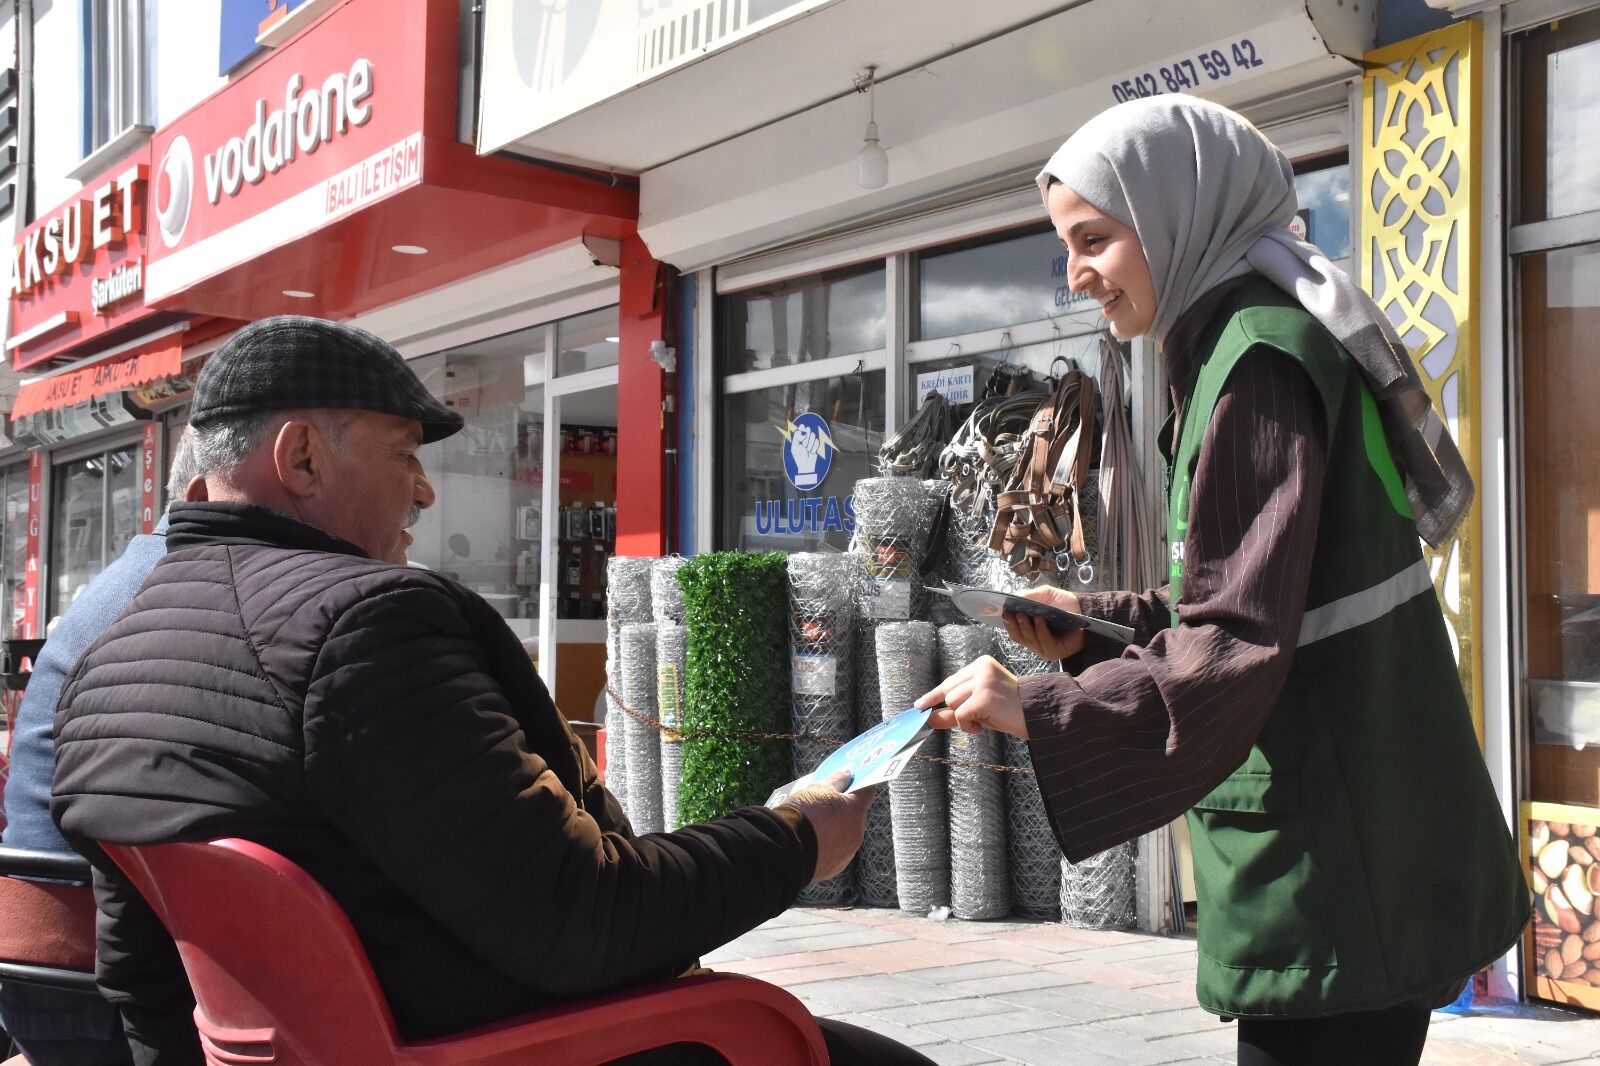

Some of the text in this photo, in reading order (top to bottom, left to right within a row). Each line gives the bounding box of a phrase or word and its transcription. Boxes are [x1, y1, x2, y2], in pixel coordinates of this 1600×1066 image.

[1111, 39, 1263, 104] 0542 847 59 42
[204, 58, 373, 205] vodafone
[360, 139, 419, 199] İLETİŞİM
[8, 164, 146, 297] AKSU ET
[921, 374, 972, 390] KREDİ KARTI
[755, 495, 856, 537] ULUTAŞ
